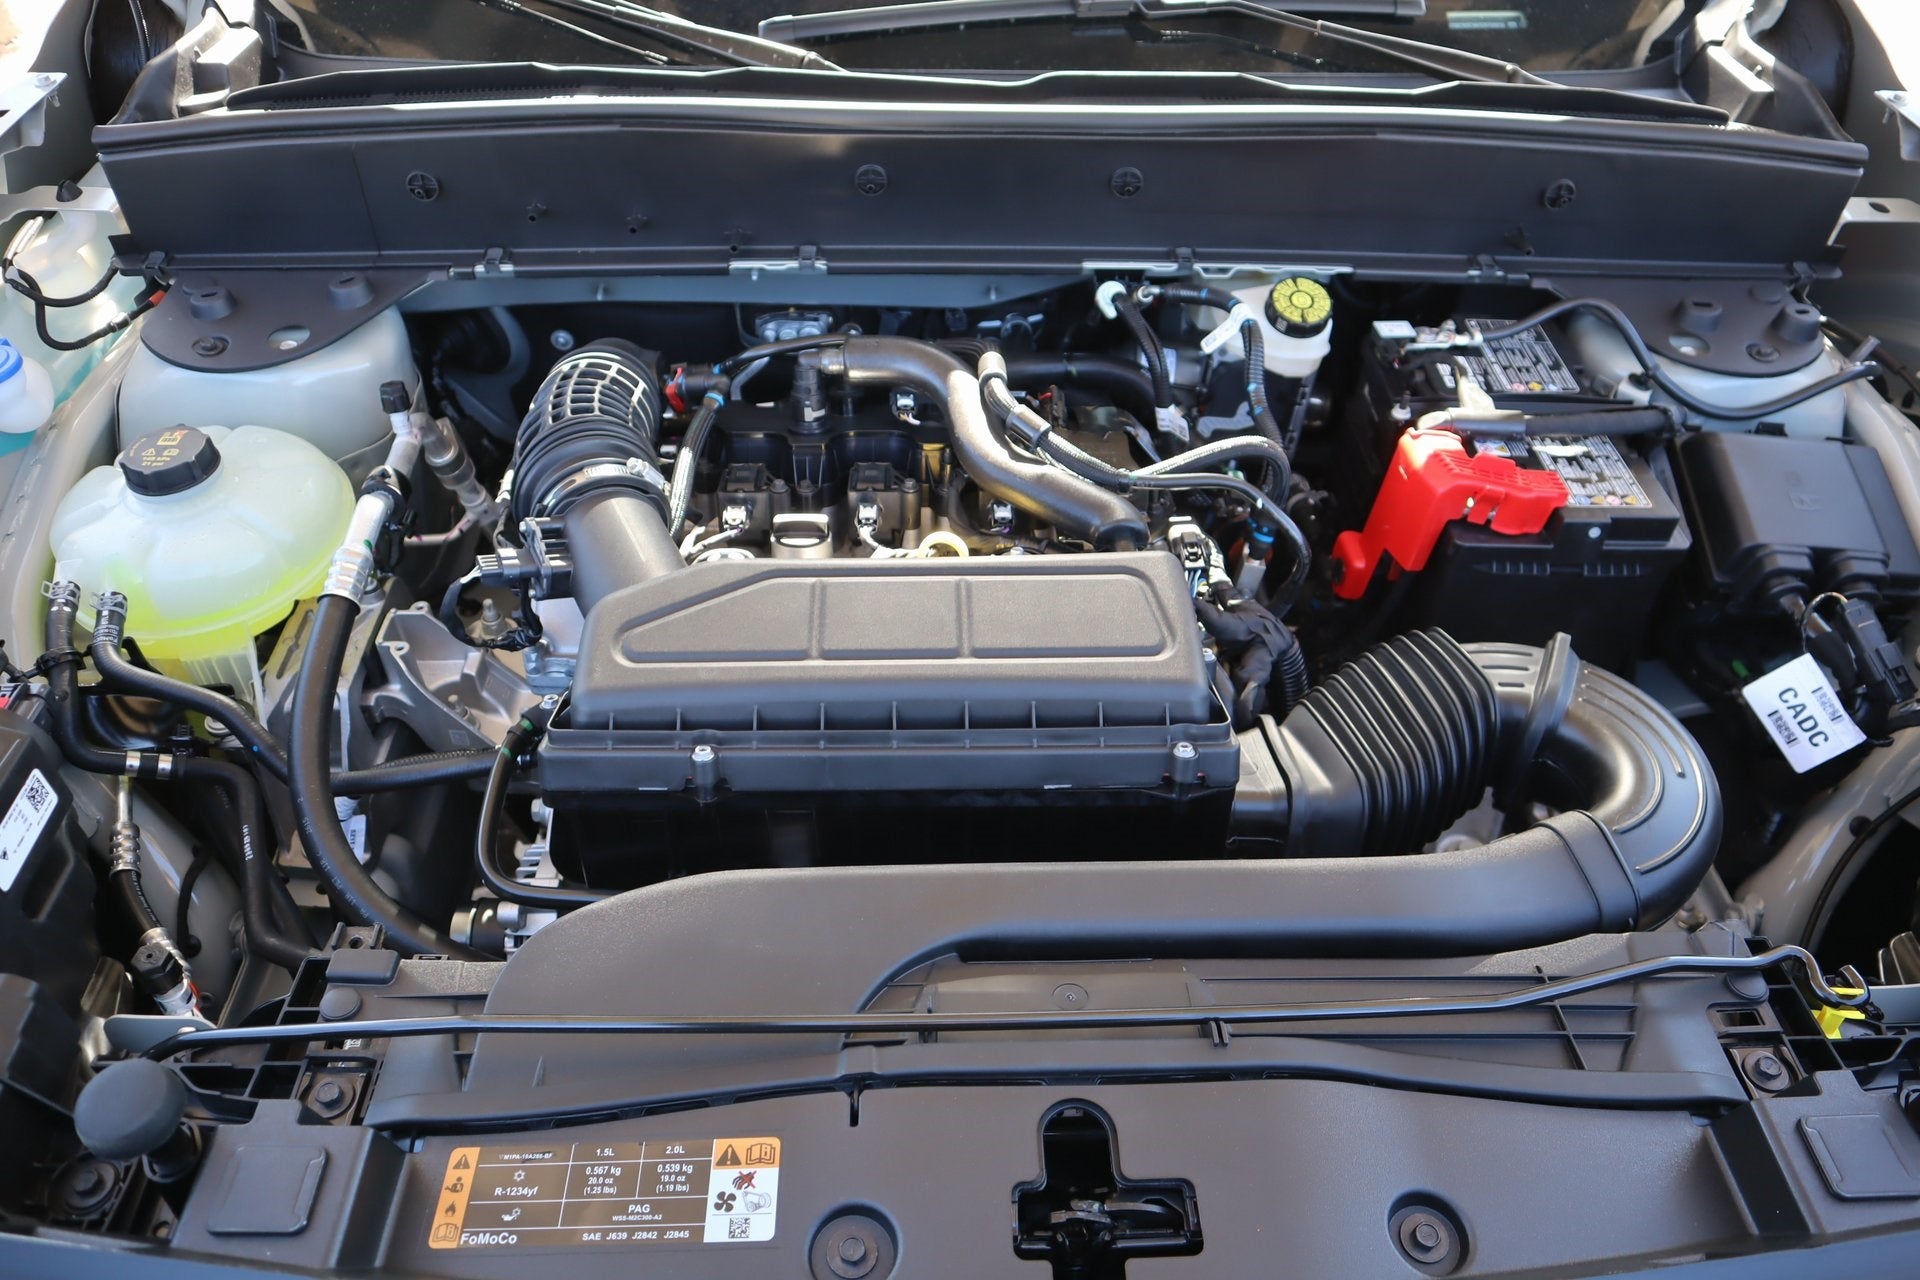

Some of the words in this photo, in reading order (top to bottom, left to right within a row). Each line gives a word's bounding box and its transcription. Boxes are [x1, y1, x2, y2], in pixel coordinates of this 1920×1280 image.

[1778, 687, 1829, 748] CADC
[596, 1148, 615, 1157] 1.5L
[665, 1146, 685, 1154] 2.0L
[586, 1166, 609, 1175] 0.567
[610, 1166, 621, 1176] kg
[657, 1164, 680, 1173] 0.539
[682, 1163, 693, 1174] kg
[588, 1177, 603, 1185] 20.0
[494, 1186, 539, 1197] R-1234yf
[583, 1186, 602, 1195] (1.25
[602, 1186, 617, 1195] lbs)
[656, 1185, 674, 1193] (1.19
[675, 1184, 689, 1193] lbs)
[628, 1204, 651, 1213] PAG
[460, 1232, 518, 1245] FoMoCo
[582, 1232, 602, 1240] SAE
[606, 1232, 628, 1240] J639
[632, 1231, 658, 1240] J2842
[664, 1230, 690, 1239] J2845
